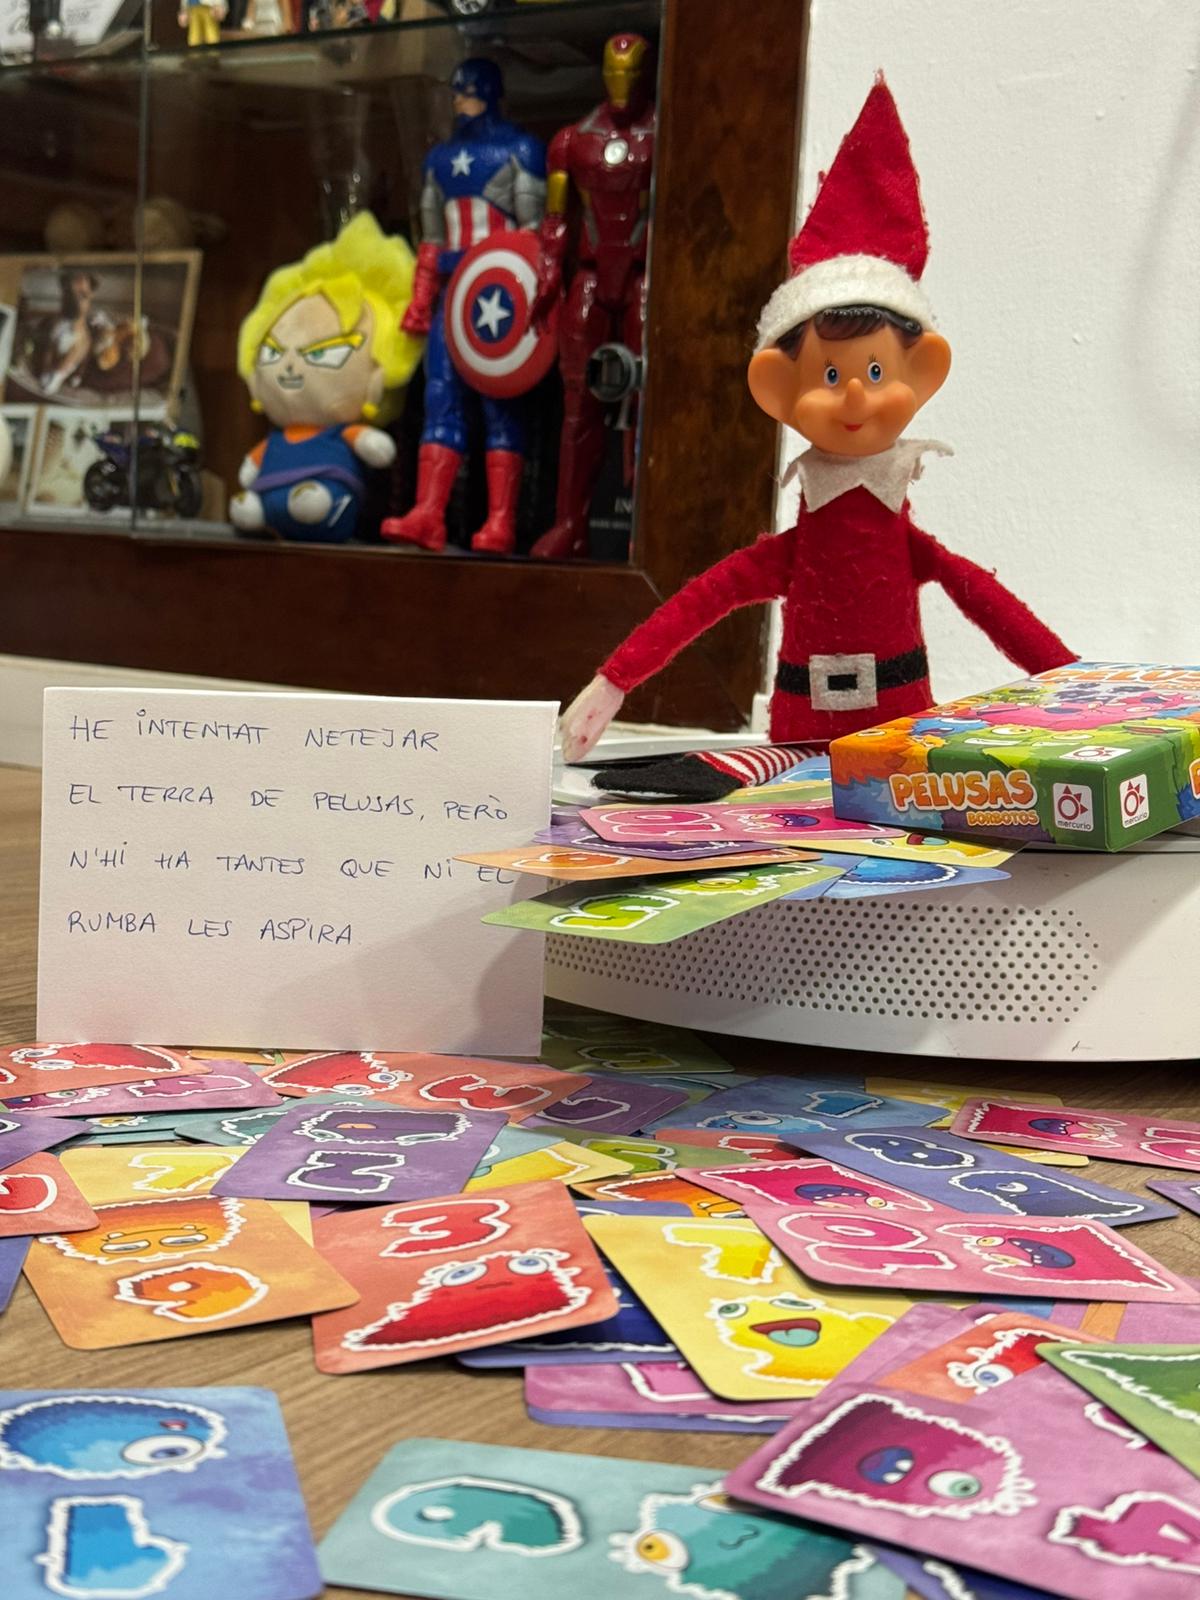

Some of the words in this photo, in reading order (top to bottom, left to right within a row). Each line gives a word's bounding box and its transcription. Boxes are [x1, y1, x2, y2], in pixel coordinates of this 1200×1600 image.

[69, 714, 115, 743] HE
[135, 707, 270, 745] INTENTAT
[304, 727, 440, 752] NETEJAR
[68, 782, 103, 805] EL
[116, 785, 216, 806] TERRA
[250, 788, 285, 808] DE
[312, 791, 425, 822] PELUSAS,
[889, 770, 1038, 811] PELUSAS
[966, 809, 1041, 826] BORBOTOS
[1056, 819, 1093, 831] mercurio
[153, 850, 193, 870] HA
[215, 853, 306, 876] TANTES
[339, 858, 394, 880] QUE
[423, 858, 453, 880] NI
[476, 865, 515, 885] EL
[67, 910, 158, 934] RUMBA
[187, 918, 233, 938] LES
[259, 917, 352, 945] ASPIRA
[378, 1197, 511, 1258] 3
